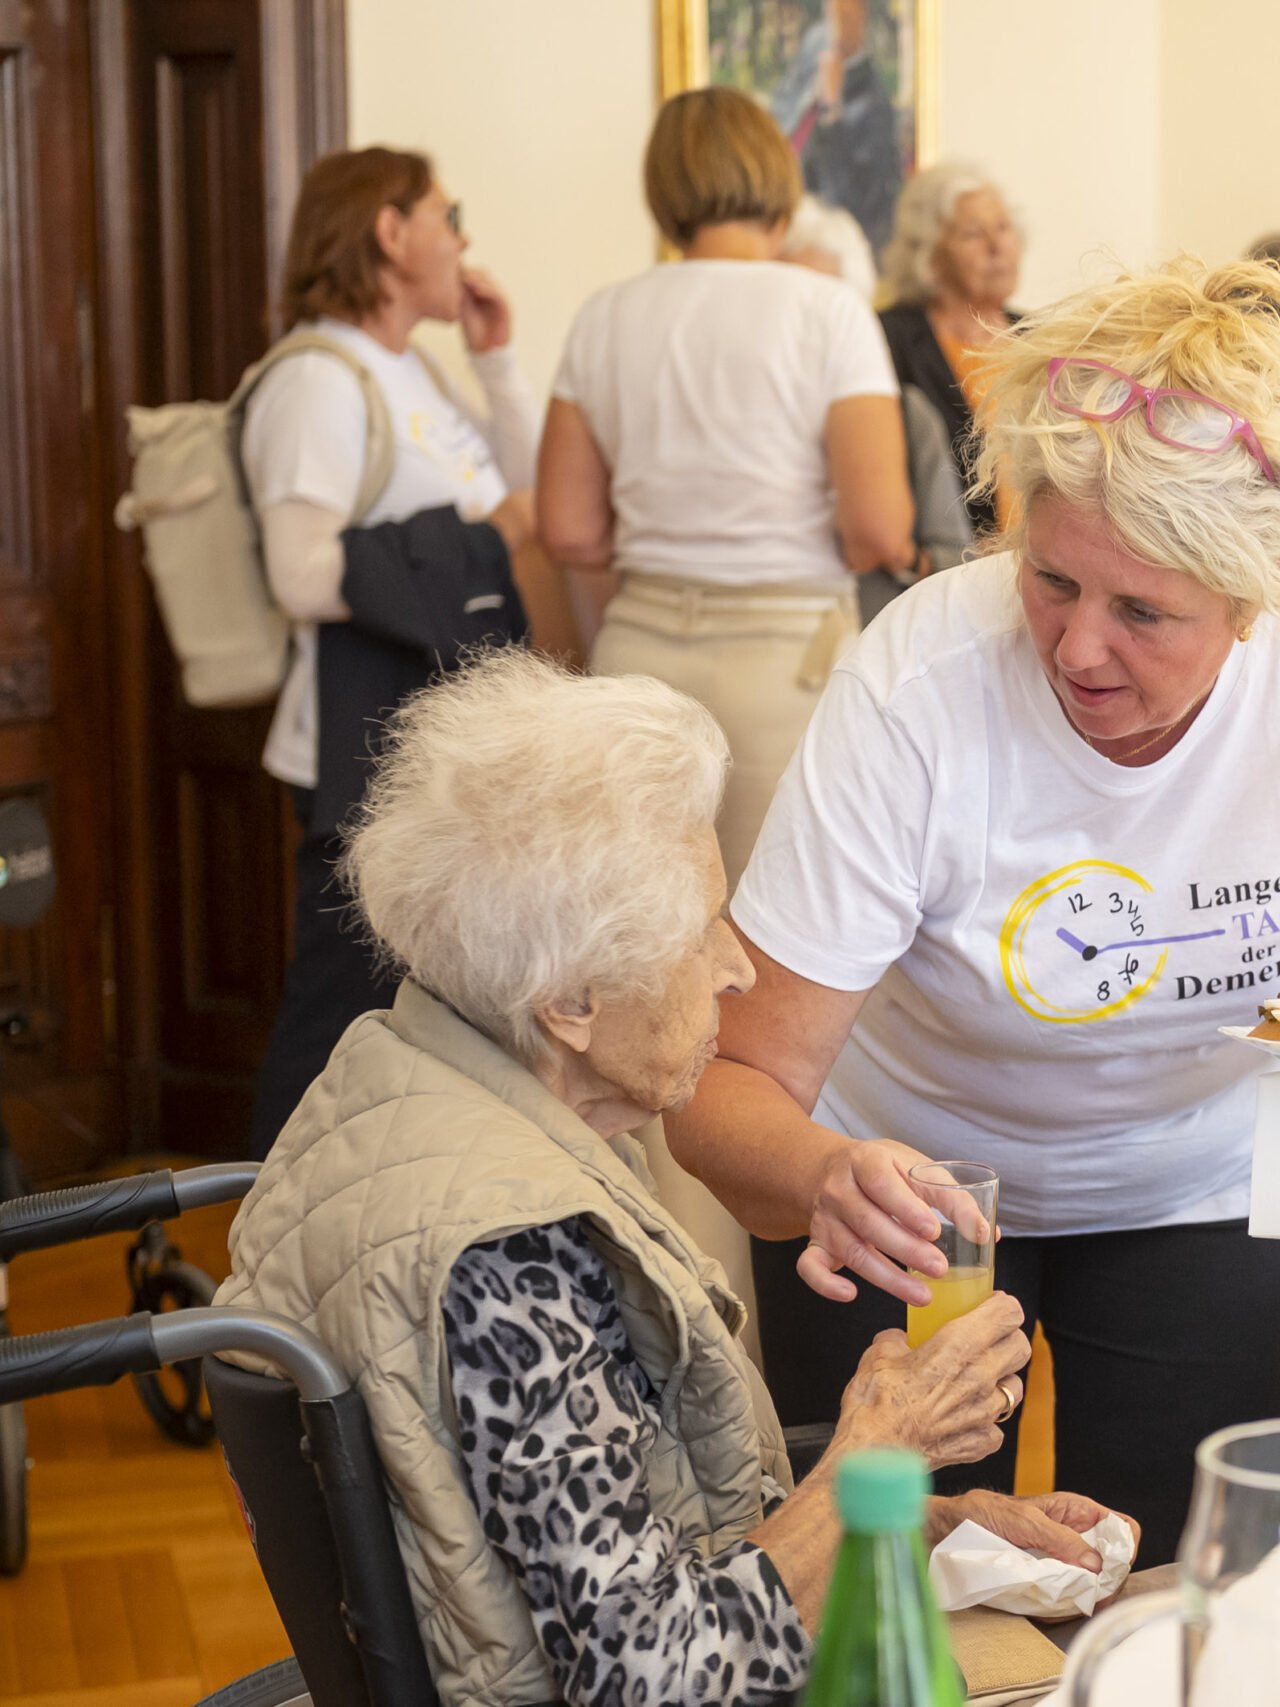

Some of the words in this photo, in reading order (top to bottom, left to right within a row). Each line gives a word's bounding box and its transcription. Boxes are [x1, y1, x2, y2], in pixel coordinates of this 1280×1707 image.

[1068, 893, 1093, 914] 12
[1108, 892, 1123, 913] 3
[1128, 899, 1139, 918] 4
[1130, 915, 1144, 936] 5
[1241, 944, 1276, 963] der
[1097, 980, 1110, 1001] 8
